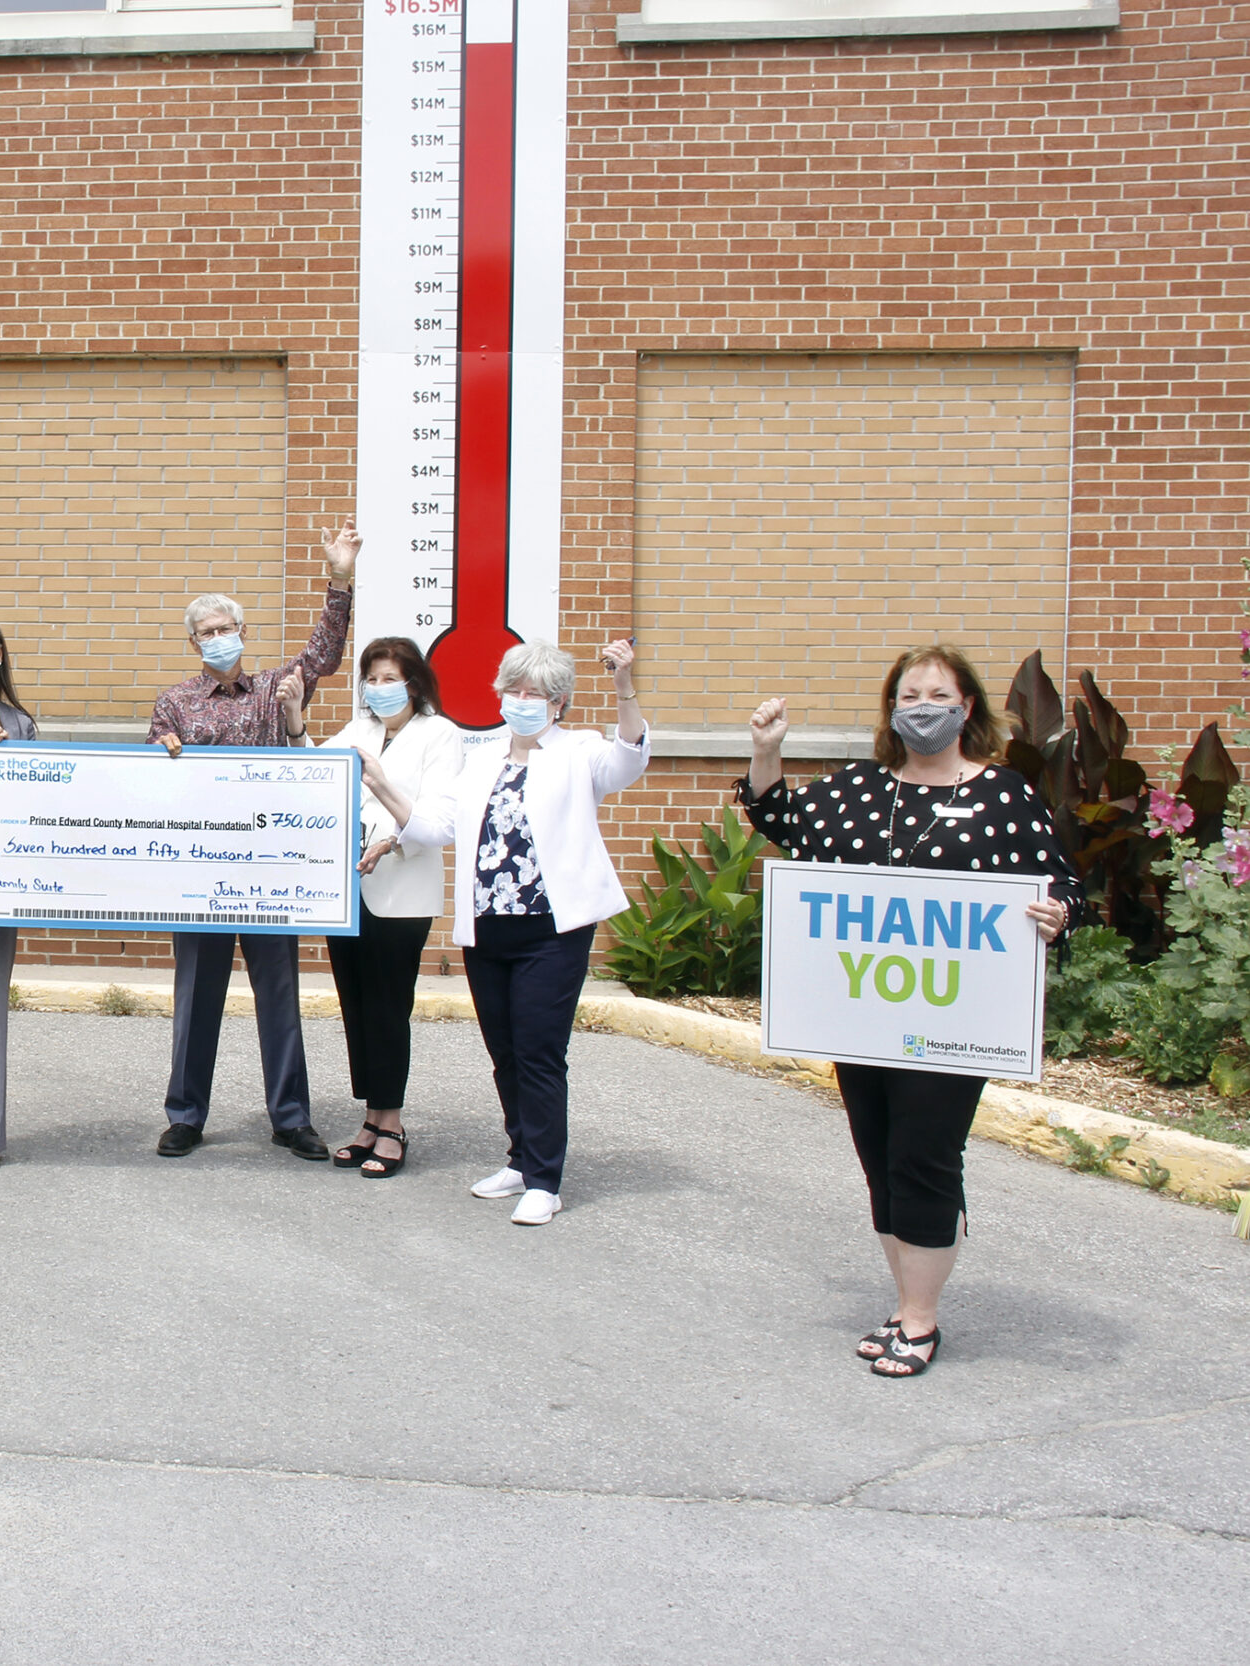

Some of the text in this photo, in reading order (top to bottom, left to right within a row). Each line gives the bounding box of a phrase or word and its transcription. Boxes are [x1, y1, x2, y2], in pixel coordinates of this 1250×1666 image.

[385, 0, 458, 16] $16.5M
[412, 24, 446, 36] $16M
[412, 61, 445, 73] $15M
[411, 98, 444, 110] $14M
[411, 135, 443, 147] $13M
[410, 171, 443, 184] $12M
[411, 208, 441, 220] $11M
[408, 244, 443, 257] $10M
[414, 281, 442, 294] $9M
[414, 318, 442, 331] $8M
[414, 354, 441, 367] $7M
[412, 391, 440, 404] $6M
[412, 428, 440, 441] $5M
[411, 465, 439, 478] $4M
[411, 502, 439, 515] $3M
[411, 539, 438, 553] $2M
[412, 576, 438, 590] $1M
[416, 614, 434, 627] $0
[462, 735, 481, 744] ade
[7, 758, 28, 769] the
[29, 758, 76, 774] County
[7, 770, 27, 781] the
[29, 770, 60, 782] Build
[301, 766, 334, 781] 2021
[29, 815, 252, 831] Prince Edward County Memorial Hospital Foundation
[256, 813, 267, 829] $
[3, 836, 45, 854] Seven
[51, 840, 106, 855] hundred
[112, 846, 136, 856] and
[147, 840, 180, 860] fifty
[188, 843, 252, 860] thousand
[33, 878, 64, 892] Suite
[213, 881, 244, 897] John
[271, 888, 288, 896] and
[295, 885, 340, 899] Bernice
[209, 900, 313, 913] Parrott Foundation
[799, 891, 1007, 952] THANK
[837, 951, 960, 1007] YOU
[926, 1040, 1026, 1057] Hospital Foundation
[927, 1050, 960, 1058] SUPPORTING
